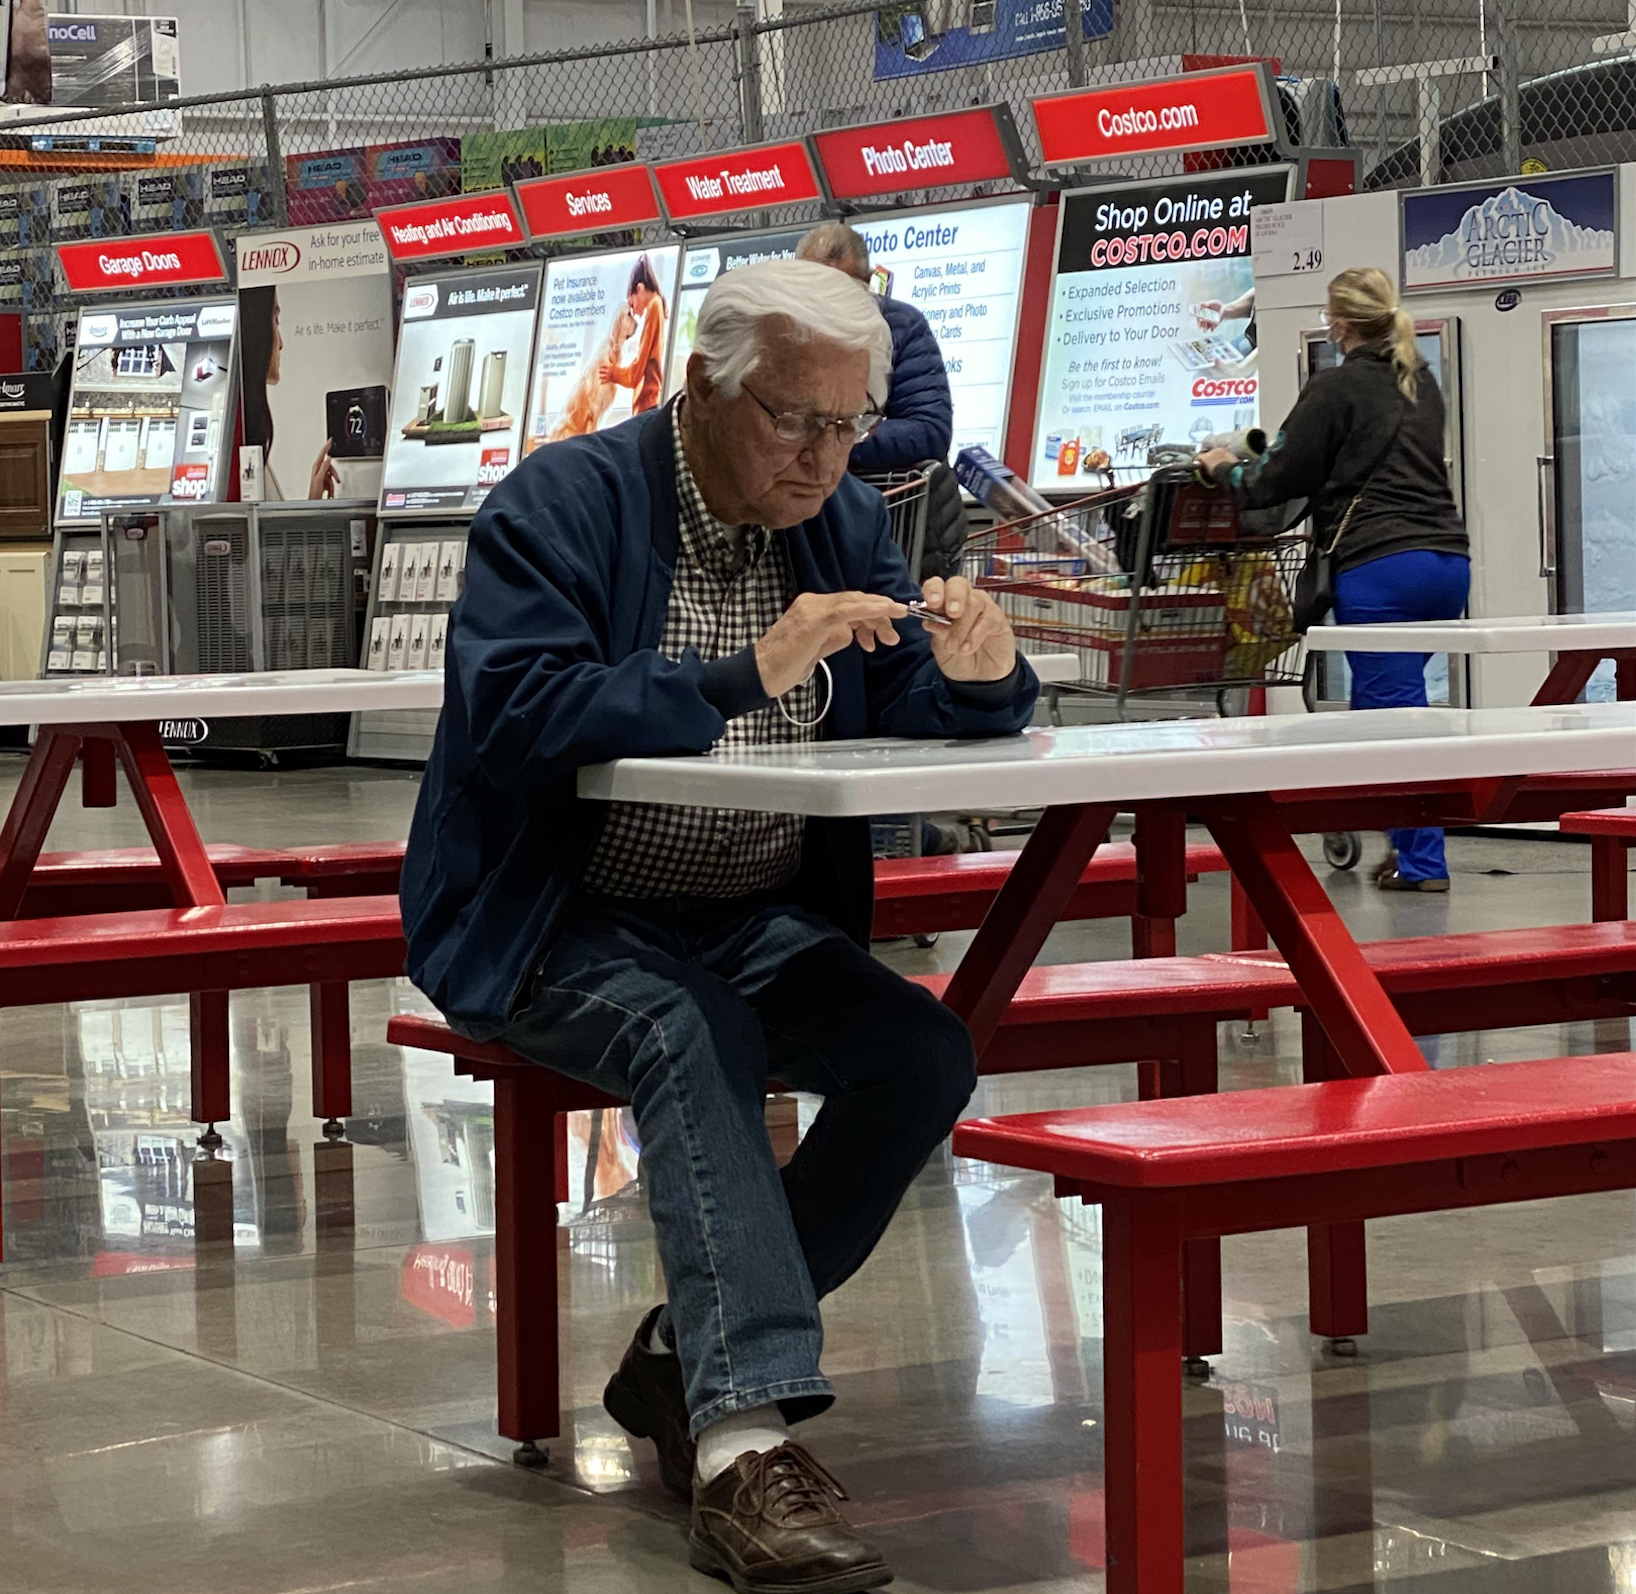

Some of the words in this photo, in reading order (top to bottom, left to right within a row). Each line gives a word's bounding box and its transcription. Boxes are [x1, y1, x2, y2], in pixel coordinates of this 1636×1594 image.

[1098, 102, 1199, 138] Costco.com
[862, 143, 905, 176] Photo
[902, 139, 956, 171] Center
[140, 182, 171, 192] HEAD
[213, 174, 246, 185] HEAD
[686, 176, 722, 200] Water
[720, 164, 784, 194] Treatment
[566, 190, 612, 216] Services
[1095, 203, 1148, 232] Shop
[1154, 194, 1224, 225] Online
[1228, 190, 1252, 218] at
[391, 224, 428, 245] Heating
[425, 219, 443, 239] and
[442, 218, 456, 236] Air
[454, 210, 512, 234] Conditioning
[1466, 202, 1548, 242] ARCTIC
[310, 234, 326, 248] Ask
[328, 232, 339, 246] for
[341, 232, 362, 248] your
[362, 228, 380, 242] free
[904, 224, 958, 250] Center
[1091, 224, 1248, 267] COSTCO.COM
[242, 247, 288, 271] LENNOX
[308, 255, 344, 270] in-home
[346, 252, 384, 266] estimate
[1292, 250, 1322, 270] 2.49
[1467, 238, 1548, 268] GLACIER
[98, 255, 142, 277] Garage
[142, 250, 181, 272] Doors
[914, 266, 943, 280] Canvas,
[946, 262, 968, 276] Metal,
[971, 259, 986, 274] and
[554, 278, 566, 290] Pet
[566, 276, 598, 288] Insurance
[912, 284, 936, 300] Acrylic
[939, 282, 962, 296] Prints
[1068, 282, 1121, 300] Expanded
[1124, 278, 1176, 294] Selection
[448, 292, 460, 305] Air
[477, 288, 494, 302] Make
[552, 294, 566, 304] now
[568, 289, 596, 303] available
[598, 290, 605, 300] to
[120, 317, 145, 328] Increase
[145, 316, 160, 326] Your
[160, 314, 174, 326] Curb
[175, 314, 196, 325] Appeal
[550, 308, 573, 320] Costco
[574, 304, 606, 317] members
[950, 305, 963, 318] and
[965, 304, 988, 318] Photo
[1066, 306, 1114, 322] Exclusive
[1117, 302, 1181, 318] Promotions
[155, 327, 176, 340] Garage
[177, 326, 192, 337] Door
[295, 325, 304, 336] Air
[306, 324, 312, 335] is
[327, 322, 346, 334] Make
[348, 321, 352, 332] it
[940, 326, 962, 340] Cards
[1064, 330, 1106, 346] Delivery
[1110, 330, 1120, 342] to
[1124, 328, 1148, 341] Your
[1152, 326, 1180, 338] Door
[945, 356, 962, 374] oks
[1069, 360, 1081, 373] Be
[1084, 359, 1098, 371] the
[1100, 358, 1120, 370] first
[1122, 358, 1132, 369] to
[1134, 356, 1163, 368] know!
[1062, 378, 1080, 391] Sign
[1082, 380, 1092, 390] up
[1094, 375, 1106, 387] for
[1108, 375, 1137, 386] Costco
[1139, 372, 1165, 385] Emails
[1192, 377, 1258, 398] COSTCO
[1068, 392, 1082, 402] Visit
[1083, 392, 1092, 402] the
[1094, 390, 1132, 402] membership
[1133, 390, 1156, 400] counter
[1062, 406, 1070, 414] Or
[1114, 404, 1122, 412] on
[1124, 402, 1160, 411] Costco.com
[349, 418, 362, 434] 72
[478, 462, 508, 482] shop
[172, 476, 206, 500] shop
[159, 720, 198, 738] LENNOX
